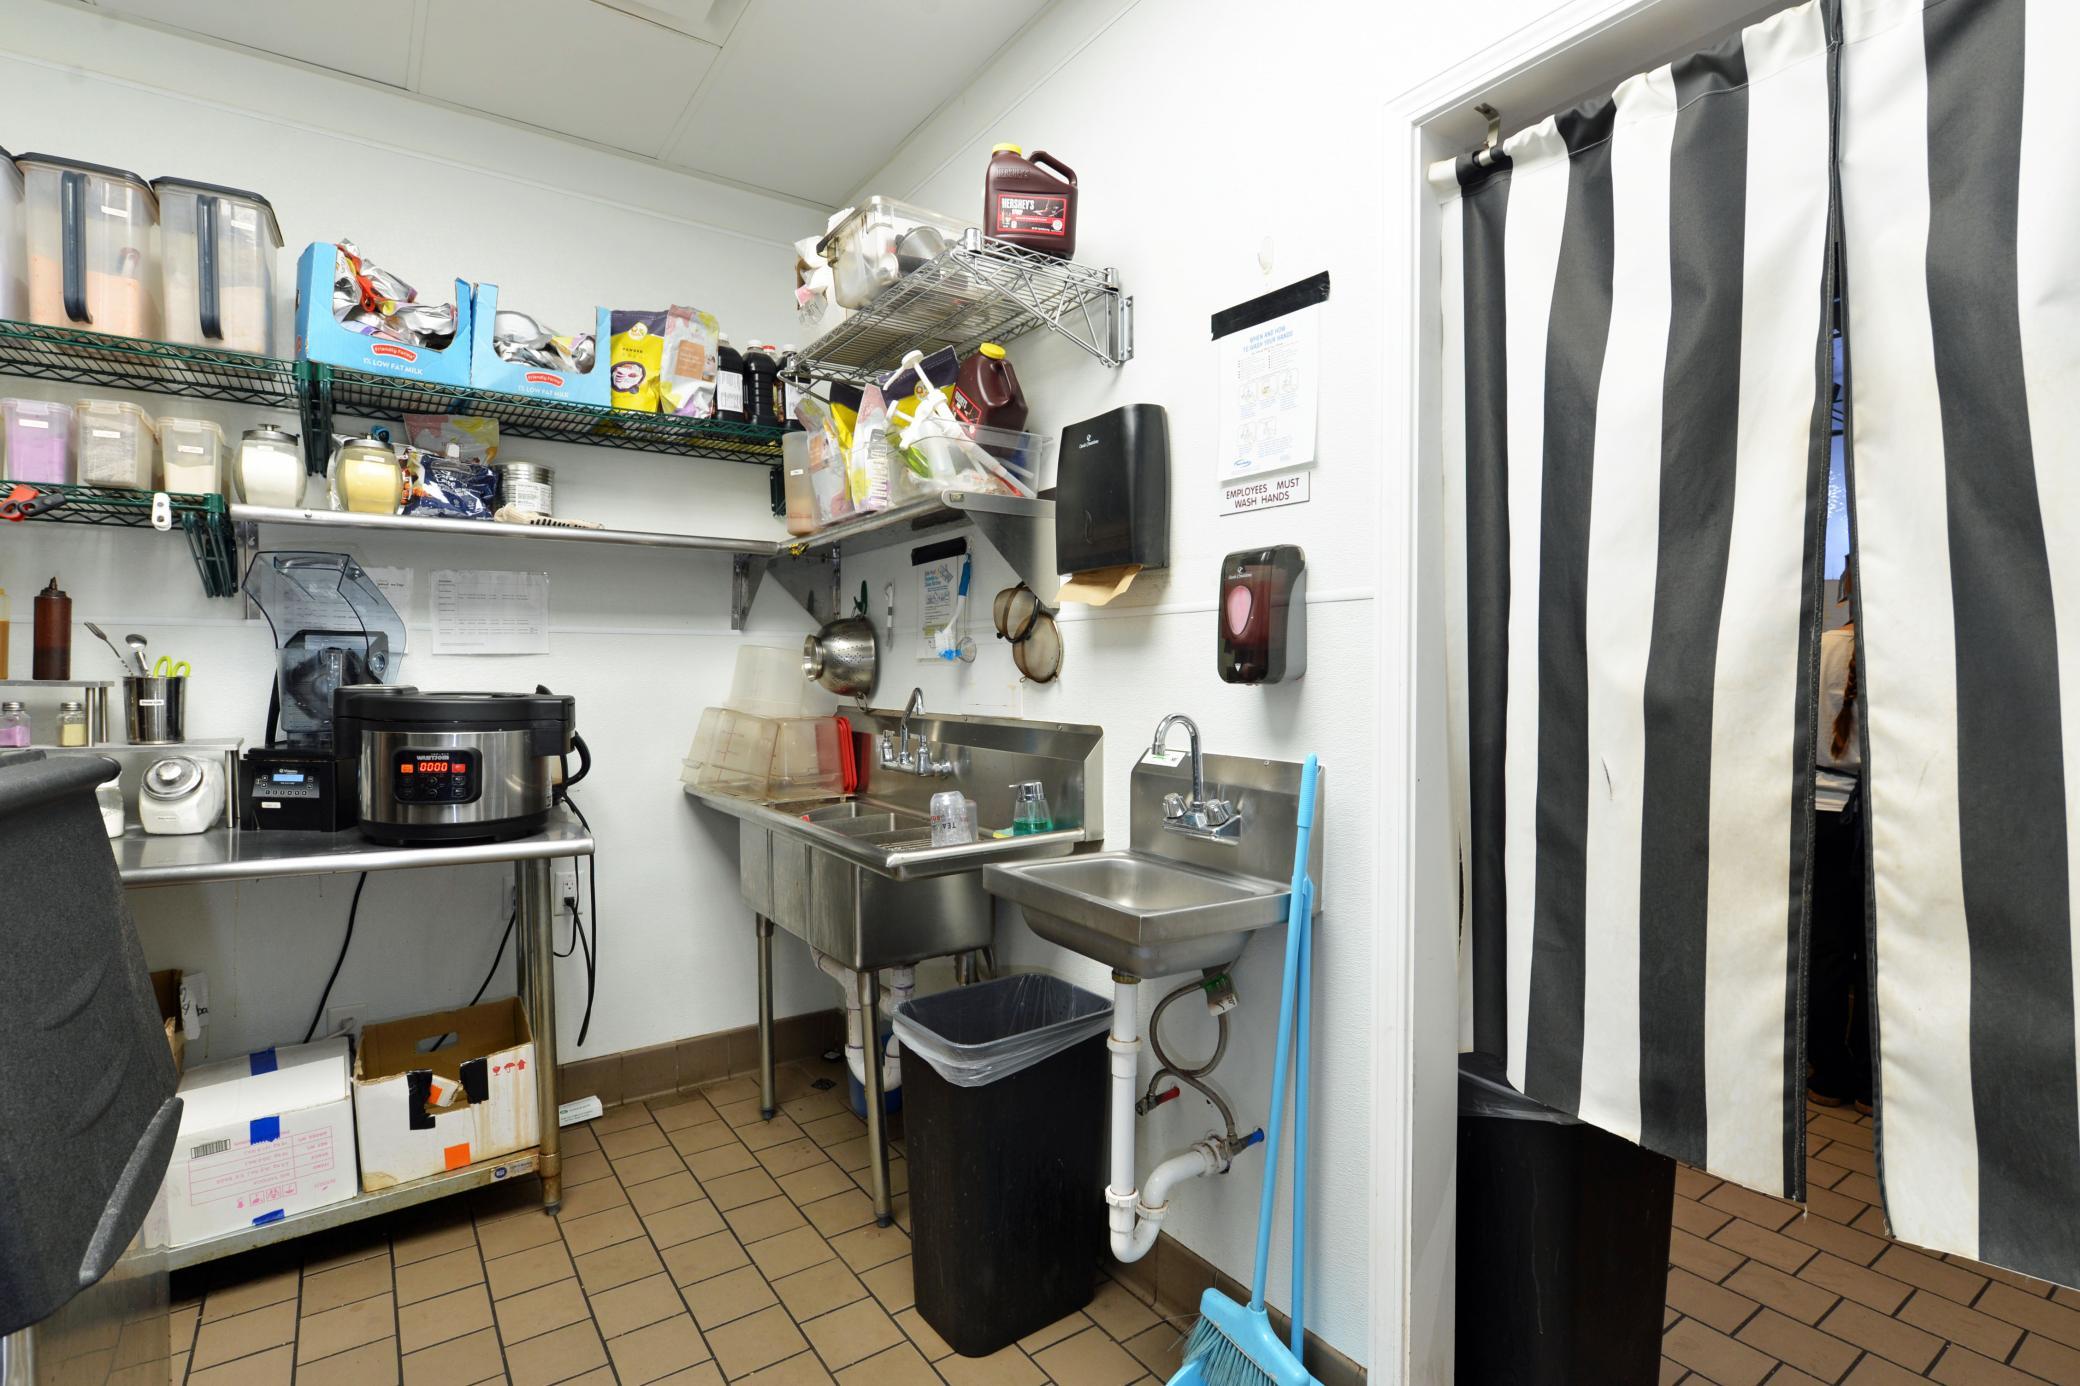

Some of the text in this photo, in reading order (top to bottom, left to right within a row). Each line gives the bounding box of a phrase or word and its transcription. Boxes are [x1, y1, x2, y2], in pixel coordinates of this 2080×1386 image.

[1002, 198, 1034, 210] HERSHEY'S
[374, 345, 415, 360] Friendly Farms
[373, 359, 390, 368] LOW
[391, 363, 404, 371] FAT
[405, 366, 423, 376] MILK
[528, 374, 547, 382] Friendly
[526, 386, 541, 394] LOW
[541, 388, 553, 396] FAT
[1226, 477, 1300, 500] EMPLOYEES MUST
[1234, 491, 1290, 509] WASH HANDS
[419, 762, 448, 772] 0000
[942, 821, 957, 830] TEA
